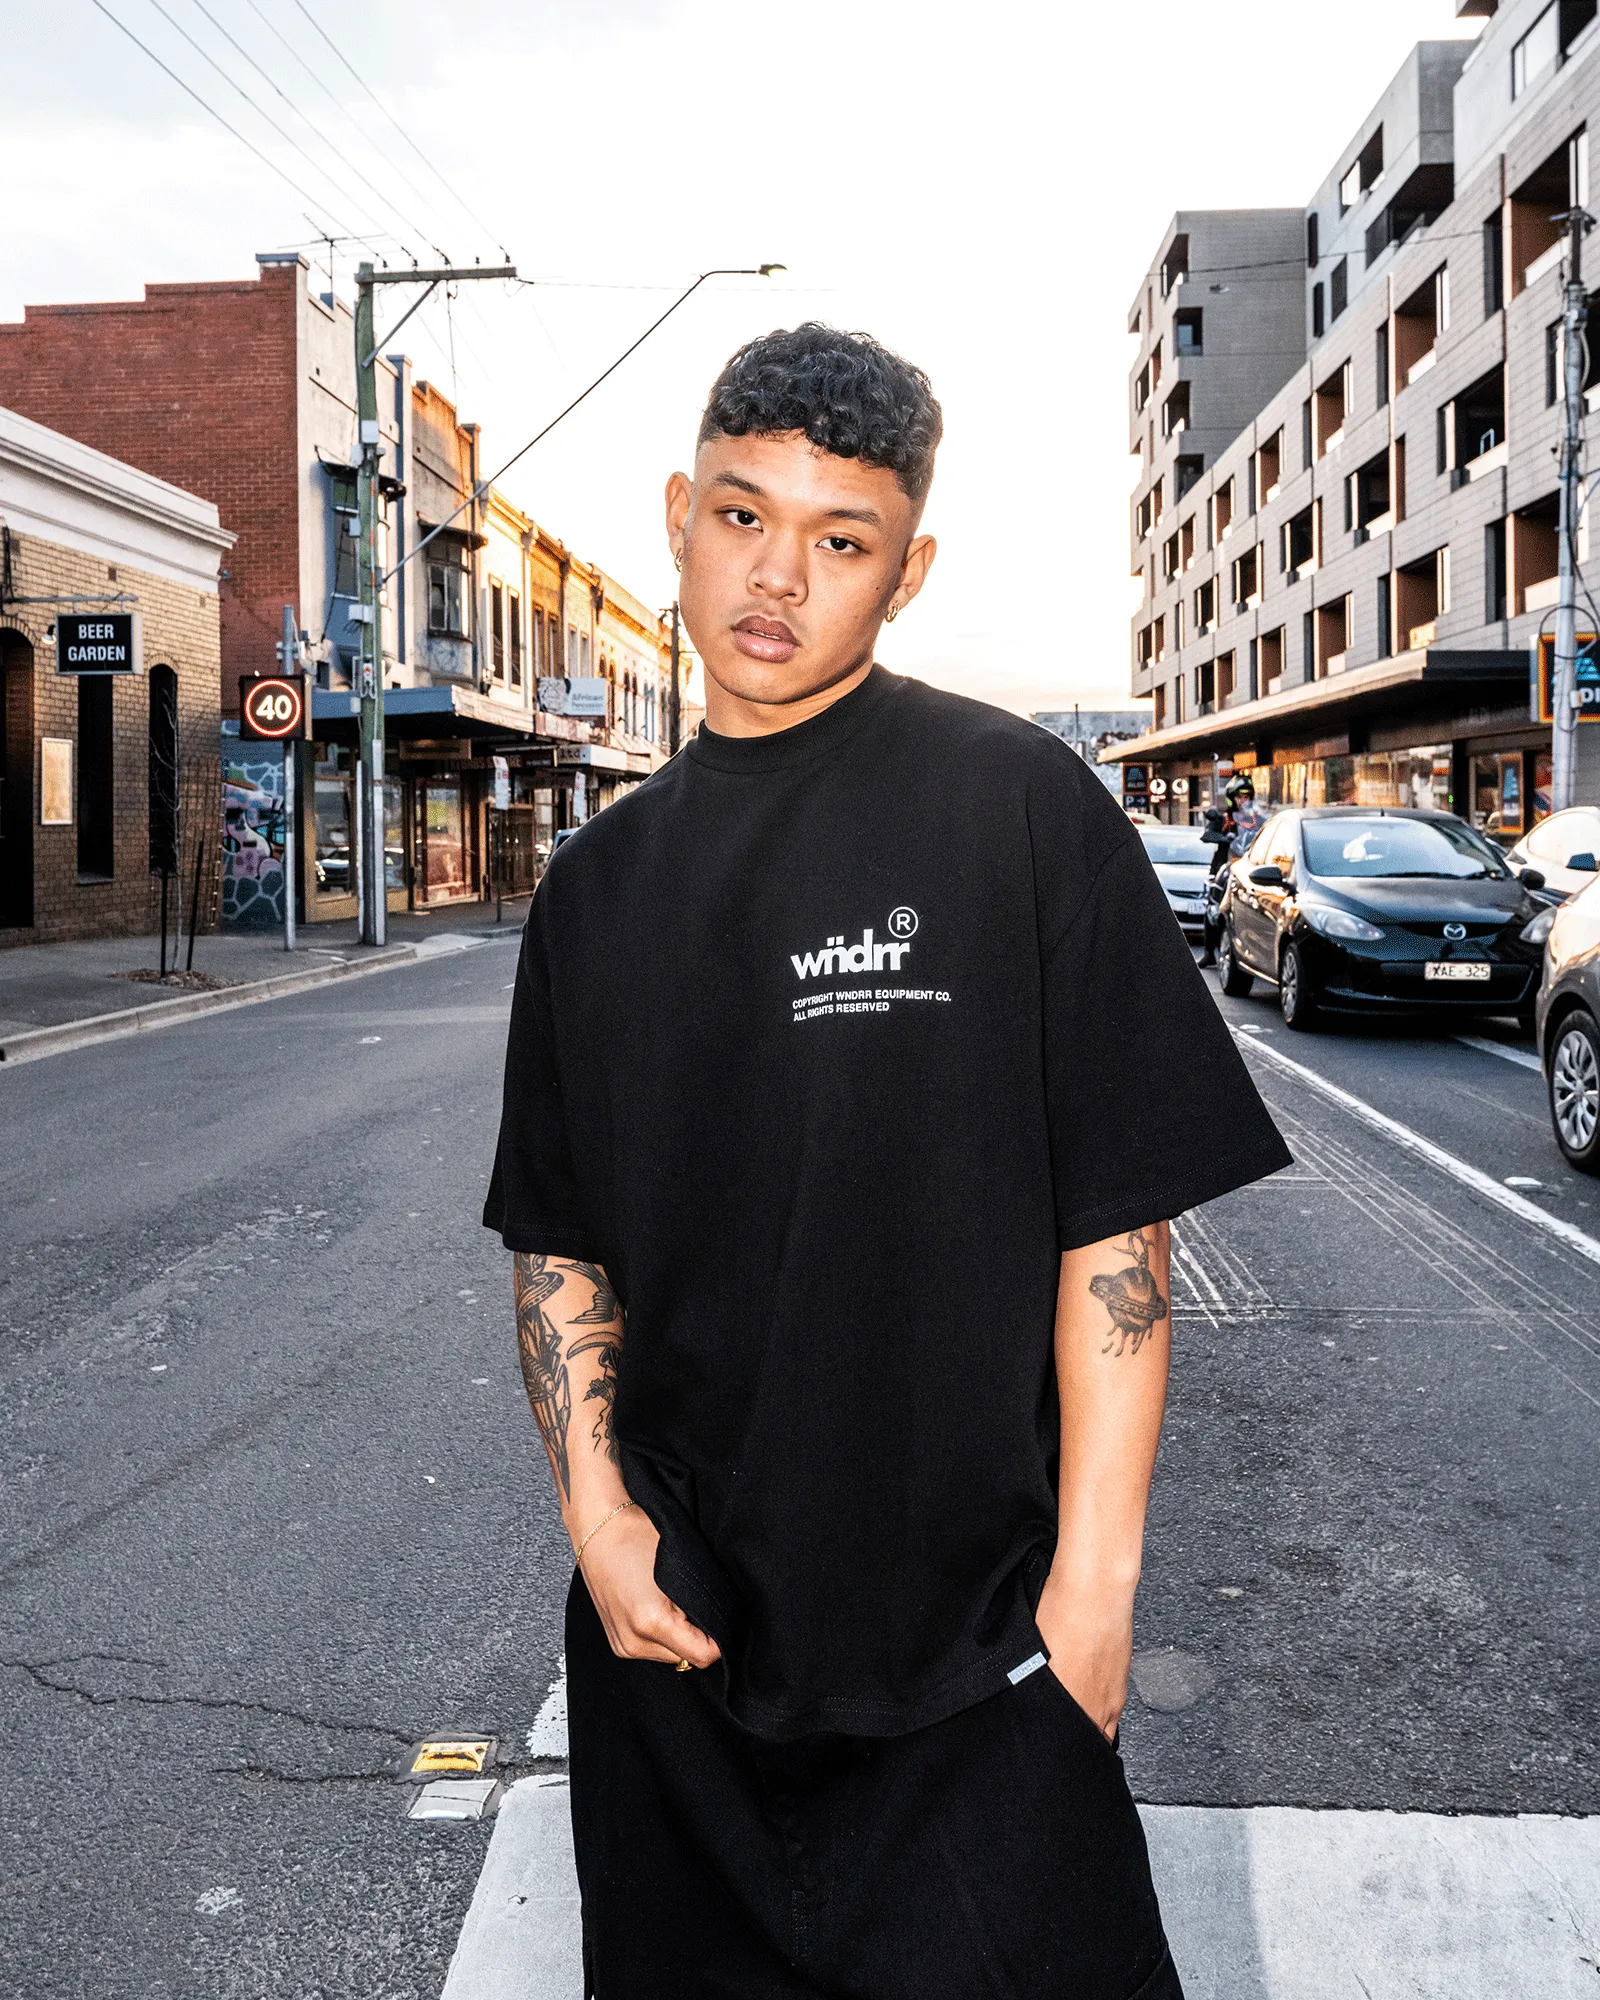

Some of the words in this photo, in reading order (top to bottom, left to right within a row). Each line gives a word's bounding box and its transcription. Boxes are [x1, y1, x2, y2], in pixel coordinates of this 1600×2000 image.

[78, 623, 114, 639] BEER
[67, 645, 126, 661] GARDEN
[255, 694, 293, 721] 40
[1125, 796, 1134, 806] P
[792, 992, 834, 1009] COPYRIGHT
[835, 990, 872, 1000] WNDRR
[875, 989, 934, 1000] EQUIPMENT
[935, 991, 952, 1002] CO.
[793, 1011, 807, 1022] ALL
[807, 1004, 834, 1018] RIGHTS
[836, 1001, 890, 1013] RESERVED
